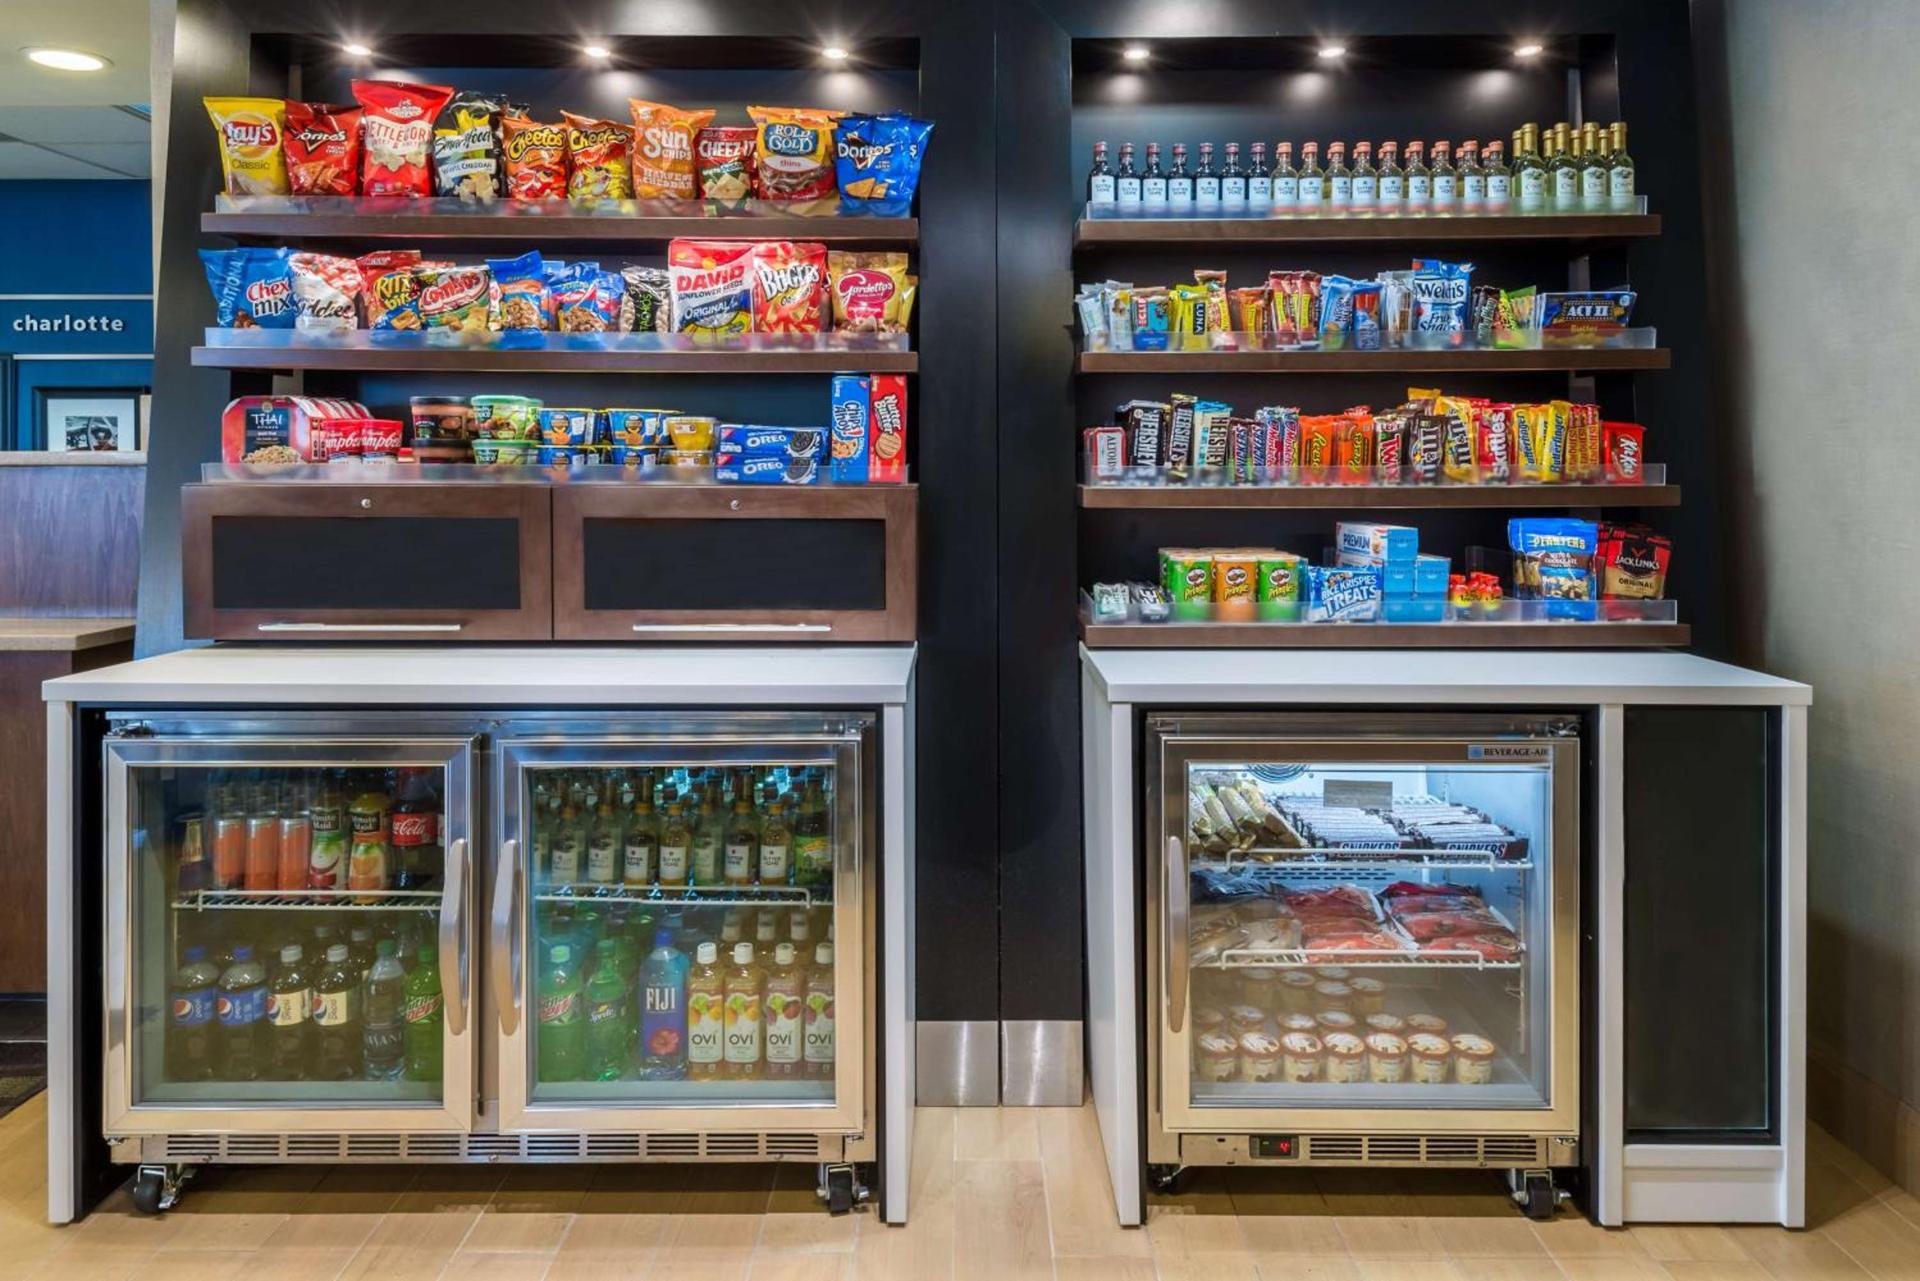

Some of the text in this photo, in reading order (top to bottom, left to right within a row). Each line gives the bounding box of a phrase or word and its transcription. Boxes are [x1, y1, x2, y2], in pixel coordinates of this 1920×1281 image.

[228, 121, 272, 146] Lay's
[776, 124, 810, 138] ROLD
[508, 127, 566, 162] Cheetos
[643, 127, 689, 159] Sun
[768, 133, 813, 151] GOLD
[838, 142, 892, 158] Doritos
[662, 148, 692, 160] CHIPS
[231, 159, 271, 170] Classic
[677, 265, 745, 292] DAVID
[247, 277, 291, 301] Chex
[678, 288, 722, 301] SUNFLOWER
[1415, 281, 1465, 300] Welch's
[253, 295, 290, 318] mix
[684, 301, 729, 320] ORIGINAL
[1567, 305, 1591, 317] ACT
[12, 314, 124, 332] charlotte
[1194, 303, 1204, 334] LUNA
[250, 413, 283, 426] THAI
[746, 434, 787, 448] OREO
[1550, 415, 1564, 473] Butterfinger
[743, 461, 784, 475] OREO
[1321, 575, 1377, 602] RICE KRISPIES
[1323, 585, 1377, 619] TREATS
[646, 986, 676, 1011] FIJI
[691, 1033, 716, 1045] OVI
[729, 1033, 753, 1045] OVI
[769, 1033, 792, 1045] OVI
[807, 1033, 831, 1045] OVI
